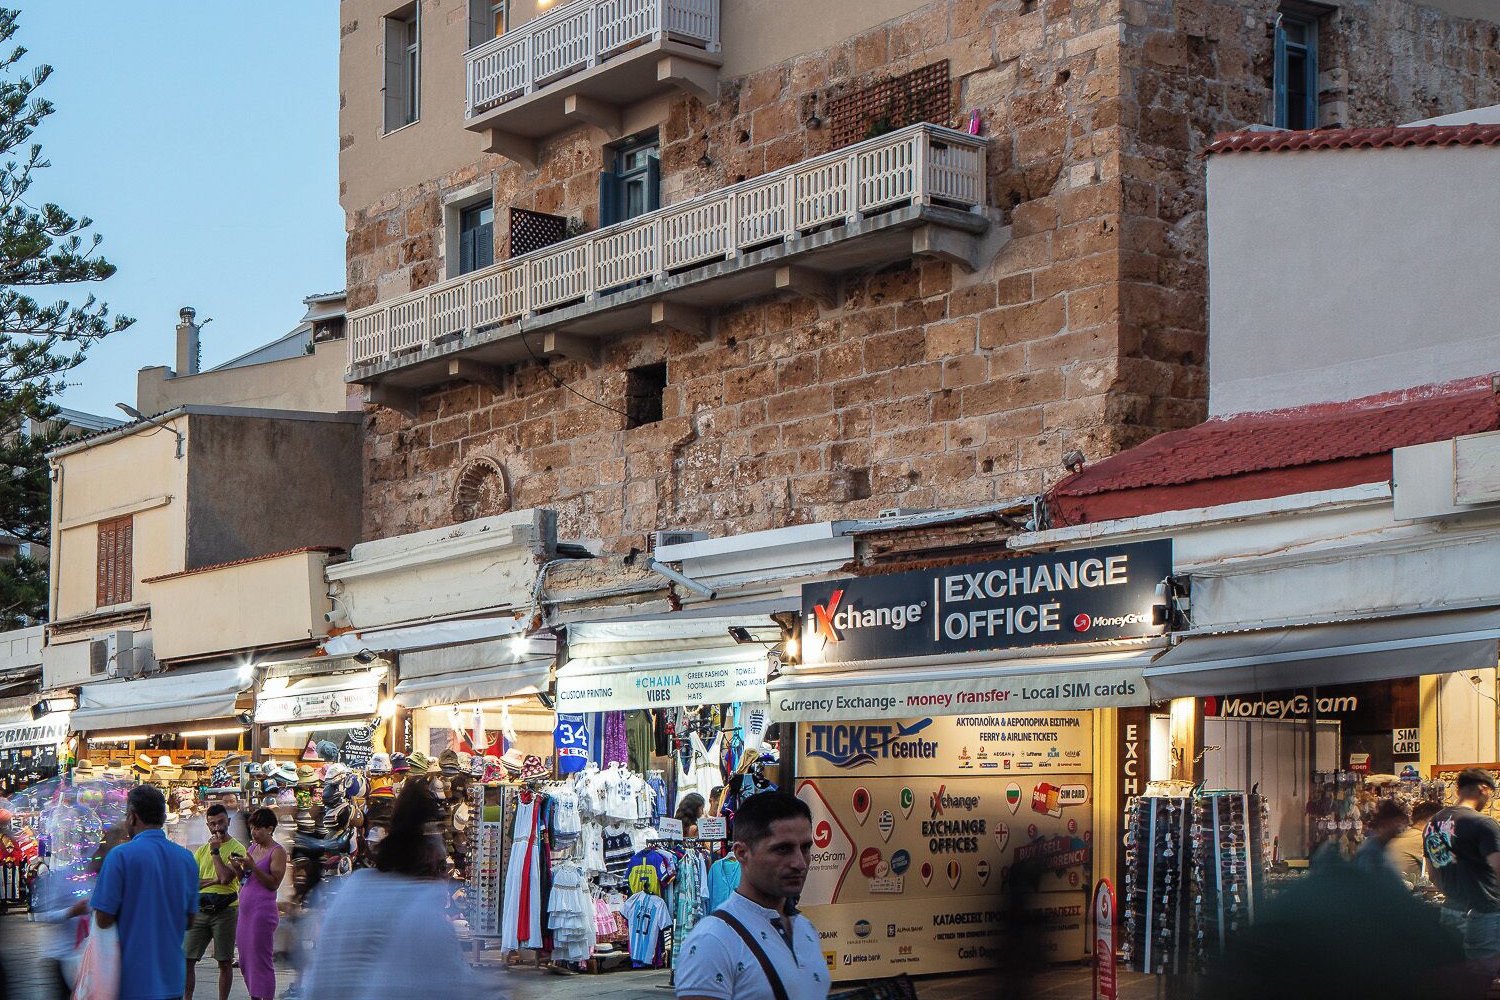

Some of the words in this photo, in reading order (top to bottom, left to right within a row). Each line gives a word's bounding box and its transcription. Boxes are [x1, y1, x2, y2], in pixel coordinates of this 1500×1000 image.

[945, 555, 1128, 602] EXCHANGE
[944, 602, 1061, 640] OFFICE
[687, 671, 704, 680] GREEK
[705, 669, 729, 679] FASHION
[735, 667, 756, 675] TOWELS
[635, 674, 681, 688] #CHANIA
[687, 681, 713, 690] FOOTBALL
[714, 680, 725, 688] SETS
[736, 679, 748, 687] AND
[749, 677, 766, 686] MORE
[560, 690, 587, 700] CUSTOM
[587, 687, 613, 698] PRINTING
[646, 689, 671, 702] VIBES
[687, 692, 702, 700] HATS
[780, 698, 834, 713] Currency
[836, 695, 896, 711] Exchange
[906, 693, 953, 708] Money
[956, 688, 1011, 704] Transfer
[1022, 684, 1059, 700] Local
[1062, 682, 1090, 698] SIM
[1094, 679, 1136, 697] cards
[956, 715, 1000, 727] ΑΚΤΟΠΛΟΪΚΑ
[1001, 717, 1006, 727] &
[559, 723, 588, 746] 34
[980, 732, 1001, 741] FERRY
[1001, 732, 1006, 741] &
[1007, 732, 1032, 741] AIRLINE
[1033, 732, 1058, 741] TICKETS
[1397, 729, 1417, 740] SIM
[891, 737, 939, 758] center
[1393, 741, 1420, 753] CARD
[1060, 789, 1071, 799] SIM
[1071, 789, 1085, 799] CARD
[921, 819, 987, 837] EXCHANGE
[929, 836, 979, 855] OFFICES
[1042, 840, 1061, 854] SELL
[820, 863, 839, 871] transfer
[932, 912, 983, 927] ΚΑΤΑΘΕΣΕΙΣ
[853, 954, 868, 962] attica
[868, 953, 881, 961] bank
[958, 945, 977, 959] Cash
